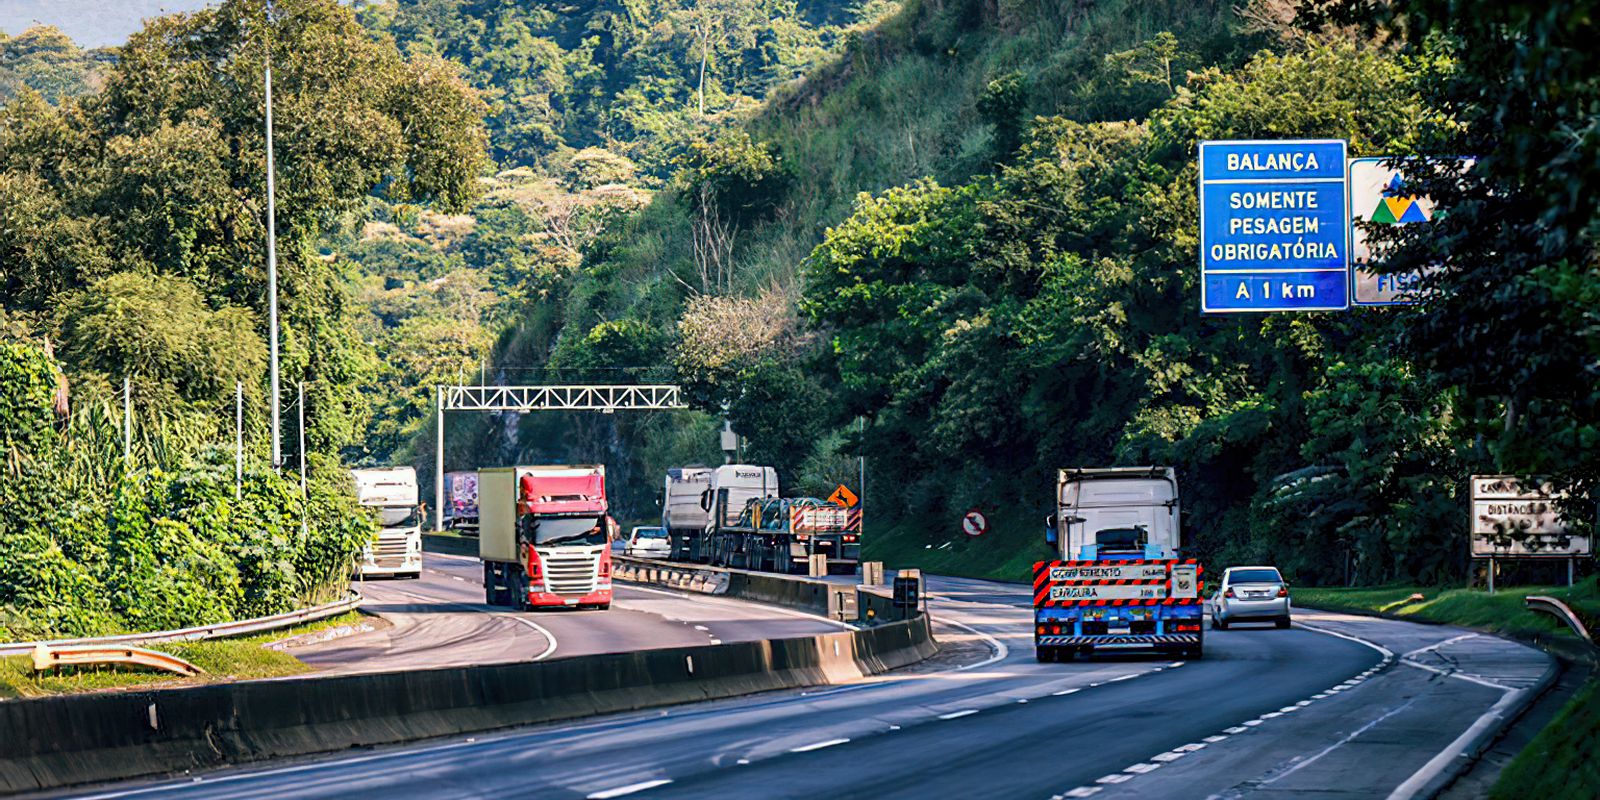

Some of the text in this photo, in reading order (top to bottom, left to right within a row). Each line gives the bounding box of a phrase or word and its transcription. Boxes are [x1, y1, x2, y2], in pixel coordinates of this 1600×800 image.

[1227, 153, 1319, 172] BALANÇA
[1230, 192, 1318, 209] SOMENTE
[1230, 217, 1319, 235] PESAGEM
[1211, 236, 1338, 261] OBRIGATÓRIA
[1235, 281, 1315, 299] A 1 km
